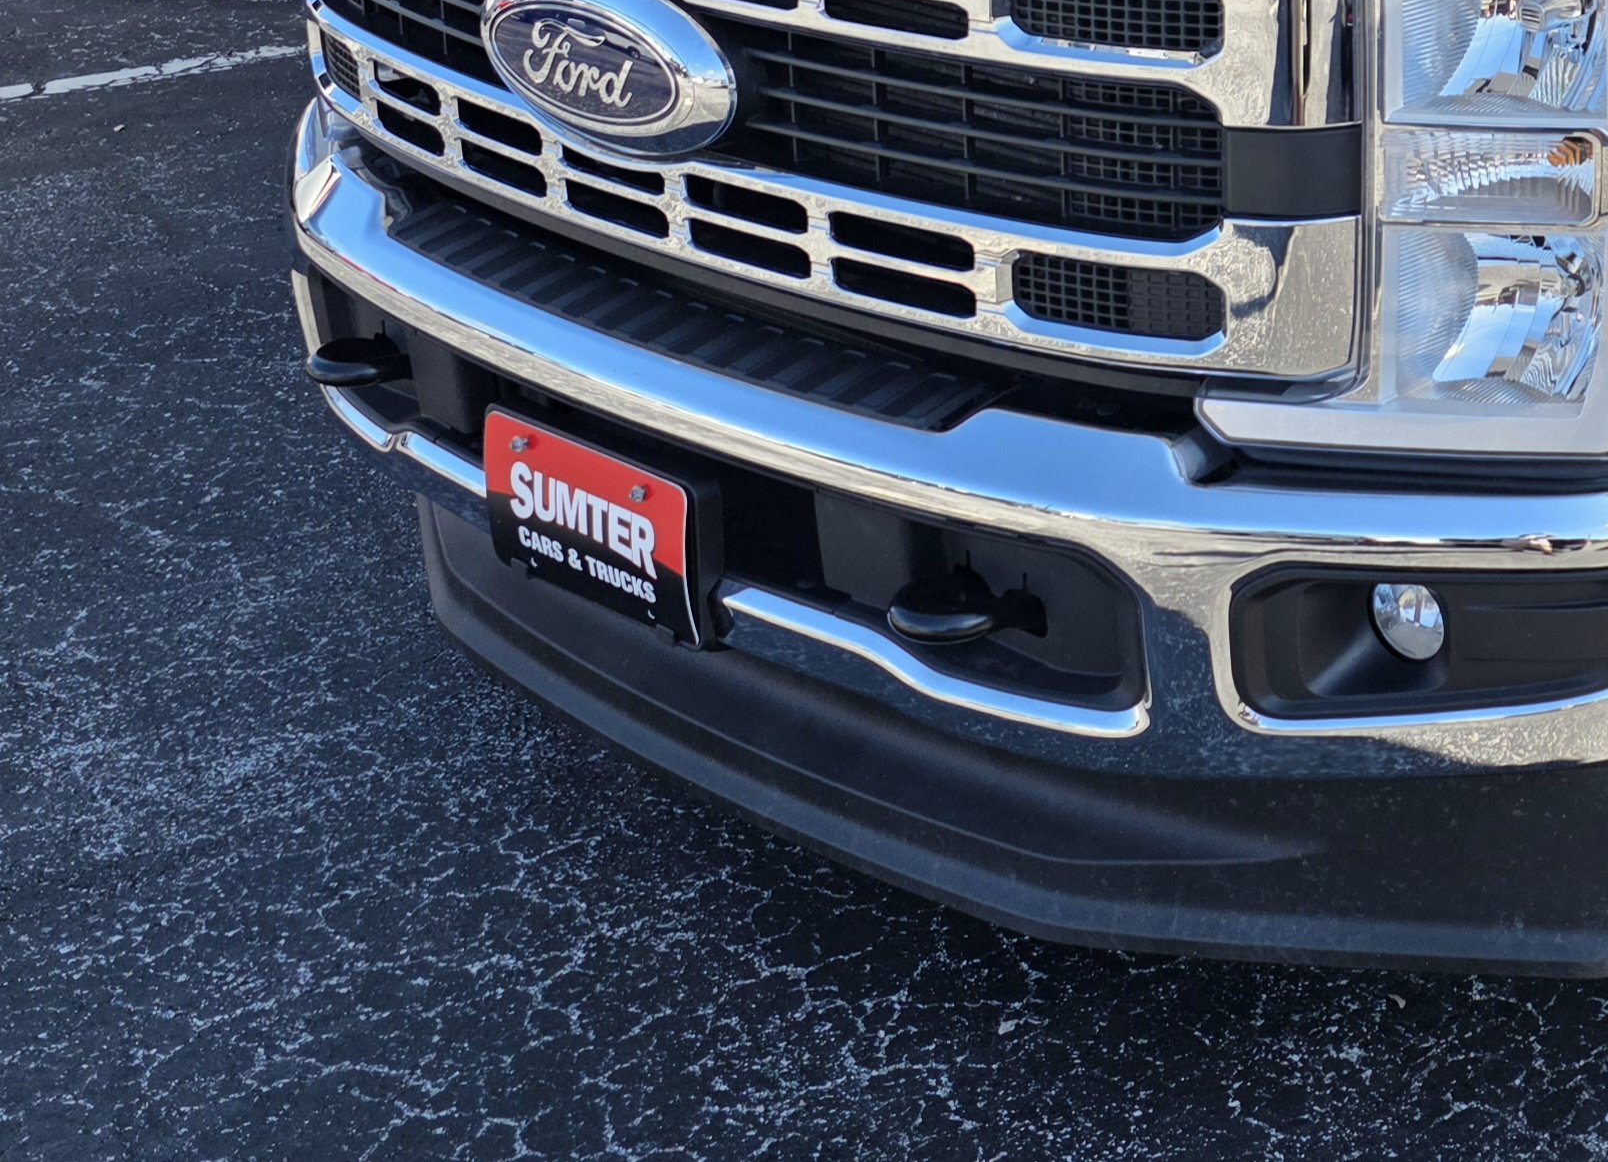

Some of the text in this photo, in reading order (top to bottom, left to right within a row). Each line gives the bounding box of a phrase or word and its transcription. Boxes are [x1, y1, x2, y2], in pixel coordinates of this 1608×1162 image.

[522, 17, 634, 108] Ford
[510, 460, 658, 580] SUMTER
[518, 525, 657, 604] CARS & TRUCKS
